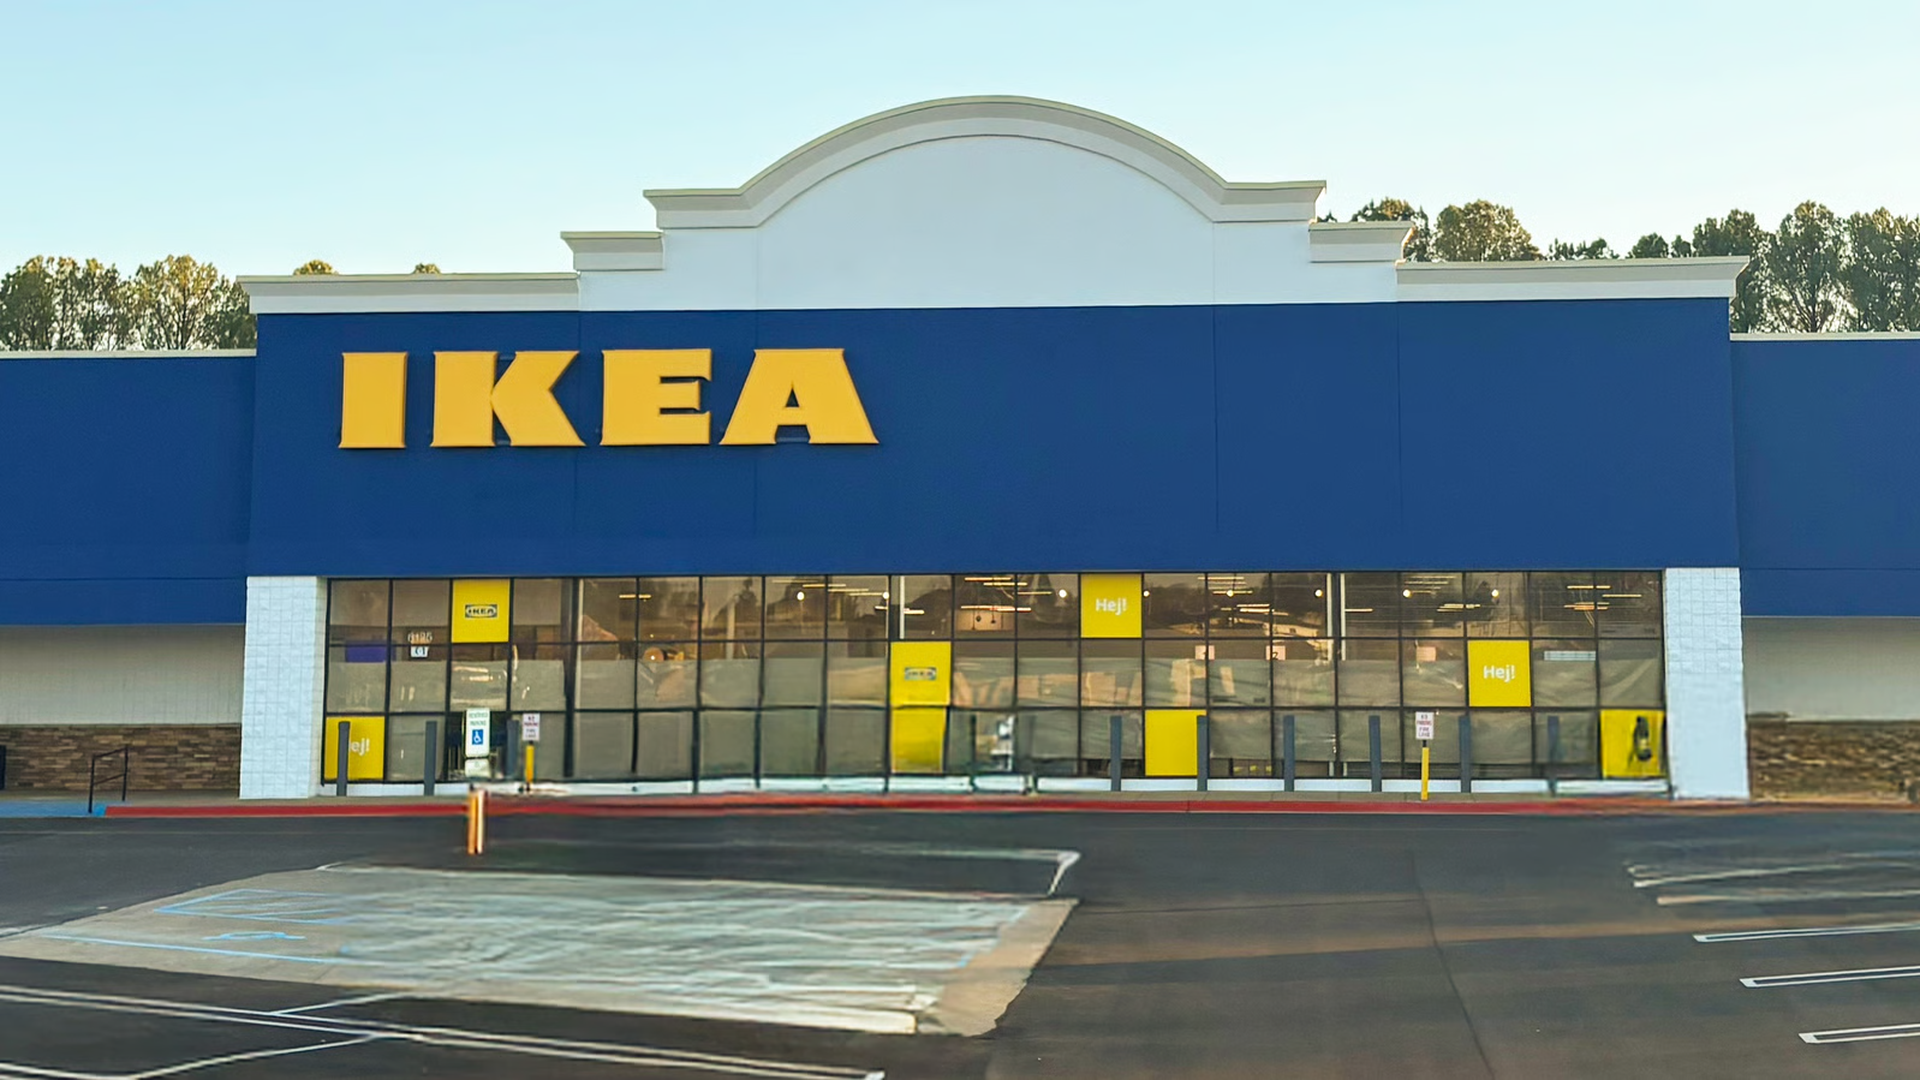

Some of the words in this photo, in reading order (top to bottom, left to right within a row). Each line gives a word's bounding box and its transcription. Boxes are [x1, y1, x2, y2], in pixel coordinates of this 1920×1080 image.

[338, 348, 880, 449] IKEA
[467, 606, 495, 616] IKEA
[1095, 597, 1127, 616] Hej!
[1483, 664, 1515, 683] Hej!
[350, 737, 370, 756] ej!
